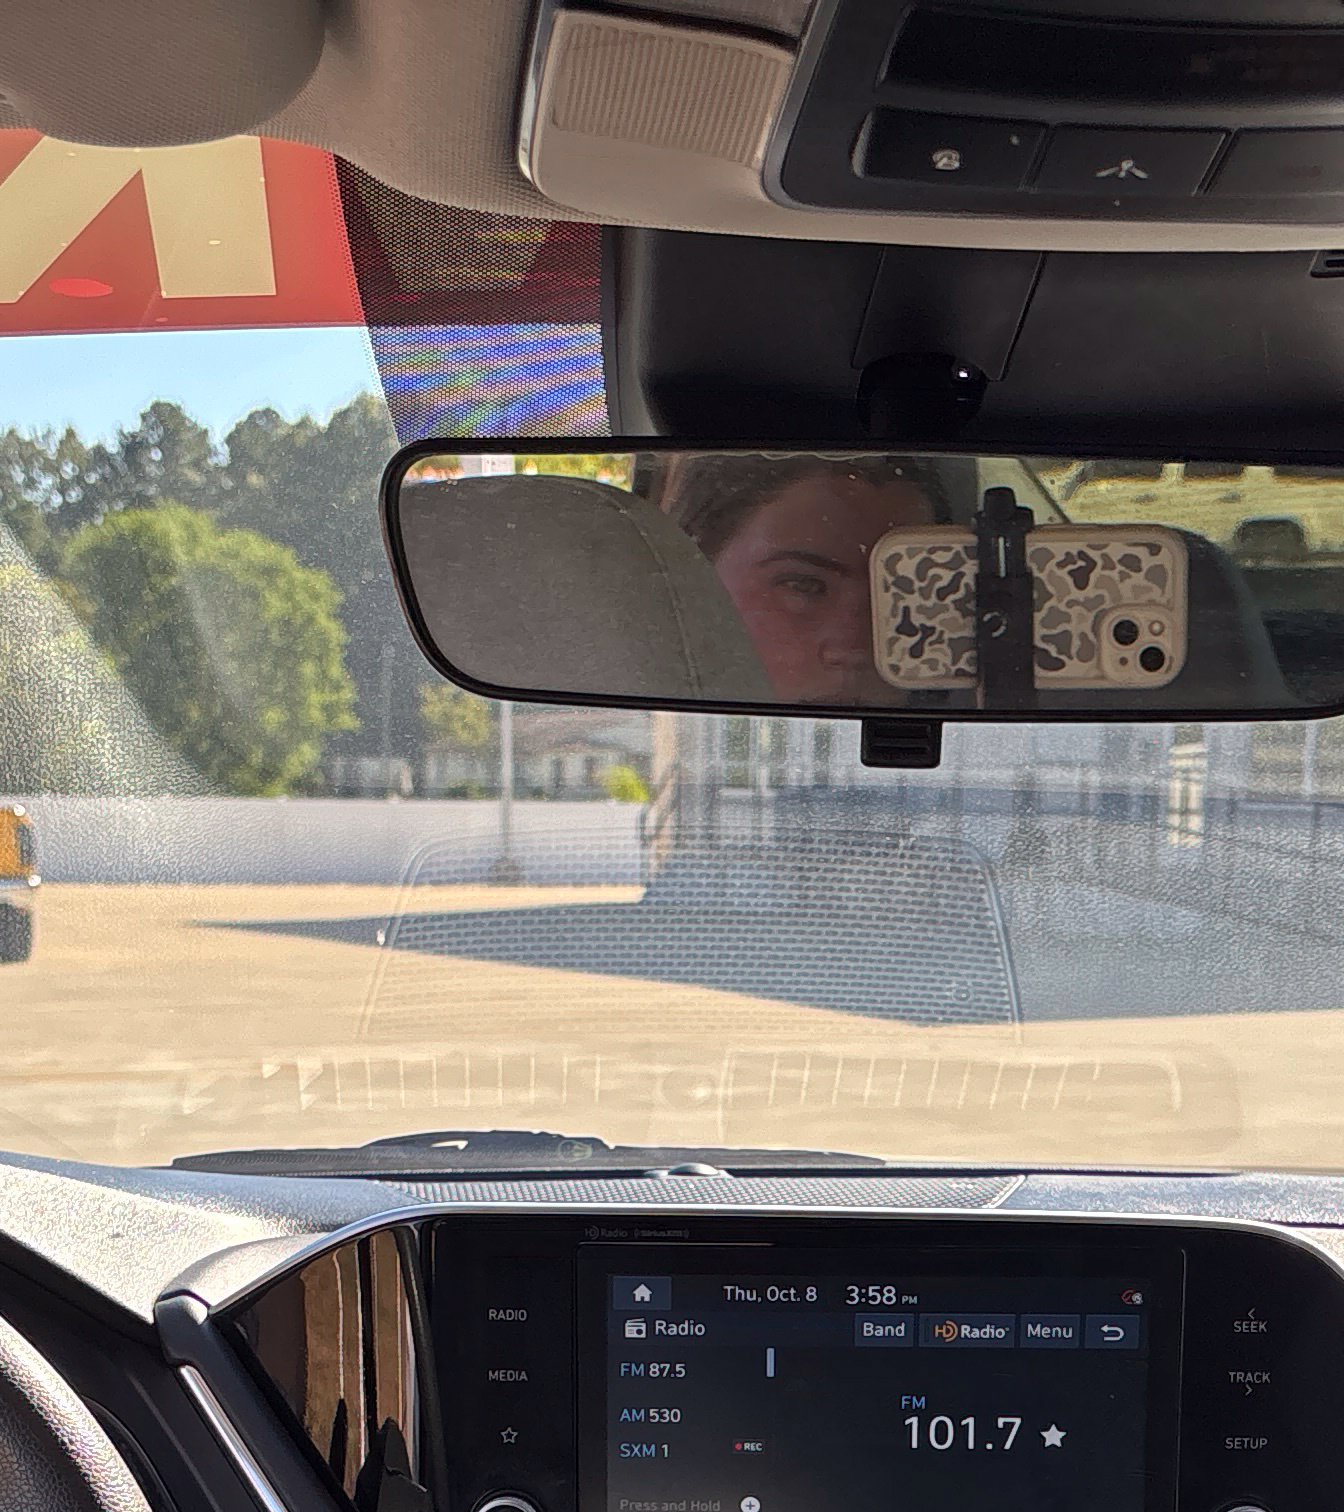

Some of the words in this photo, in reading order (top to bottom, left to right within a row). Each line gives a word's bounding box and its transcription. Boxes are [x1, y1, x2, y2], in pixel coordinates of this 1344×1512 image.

[723, 1286, 762, 1303] Thu,
[766, 1286, 801, 1302] Oct.
[806, 1286, 818, 1302] 8
[846, 1286, 897, 1305] 3:58
[902, 1295, 918, 1304] PM
[488, 1308, 528, 1321] RADIO
[655, 1320, 706, 1336] Radio
[863, 1322, 906, 1337] Band
[1026, 1324, 1073, 1339] Menu
[1233, 1320, 1268, 1333] SEEK
[488, 1369, 528, 1382] MEDIA
[620, 1362, 645, 1377] FM
[649, 1363, 686, 1378] 87.5
[1228, 1371, 1271, 1384] TRACK
[901, 1395, 926, 1410] FM
[619, 1408, 645, 1423] AM
[649, 1408, 681, 1424] 530
[904, 1416, 1023, 1451] 101.7
[619, 1443, 656, 1458] SXM
[661, 1443, 670, 1458] 1
[743, 1442, 764, 1452] REC
[1224, 1437, 1268, 1450] SETUP
[619, 1499, 657, 1512] Press
[661, 1499, 687, 1512] and
[690, 1499, 721, 1512] Hold
